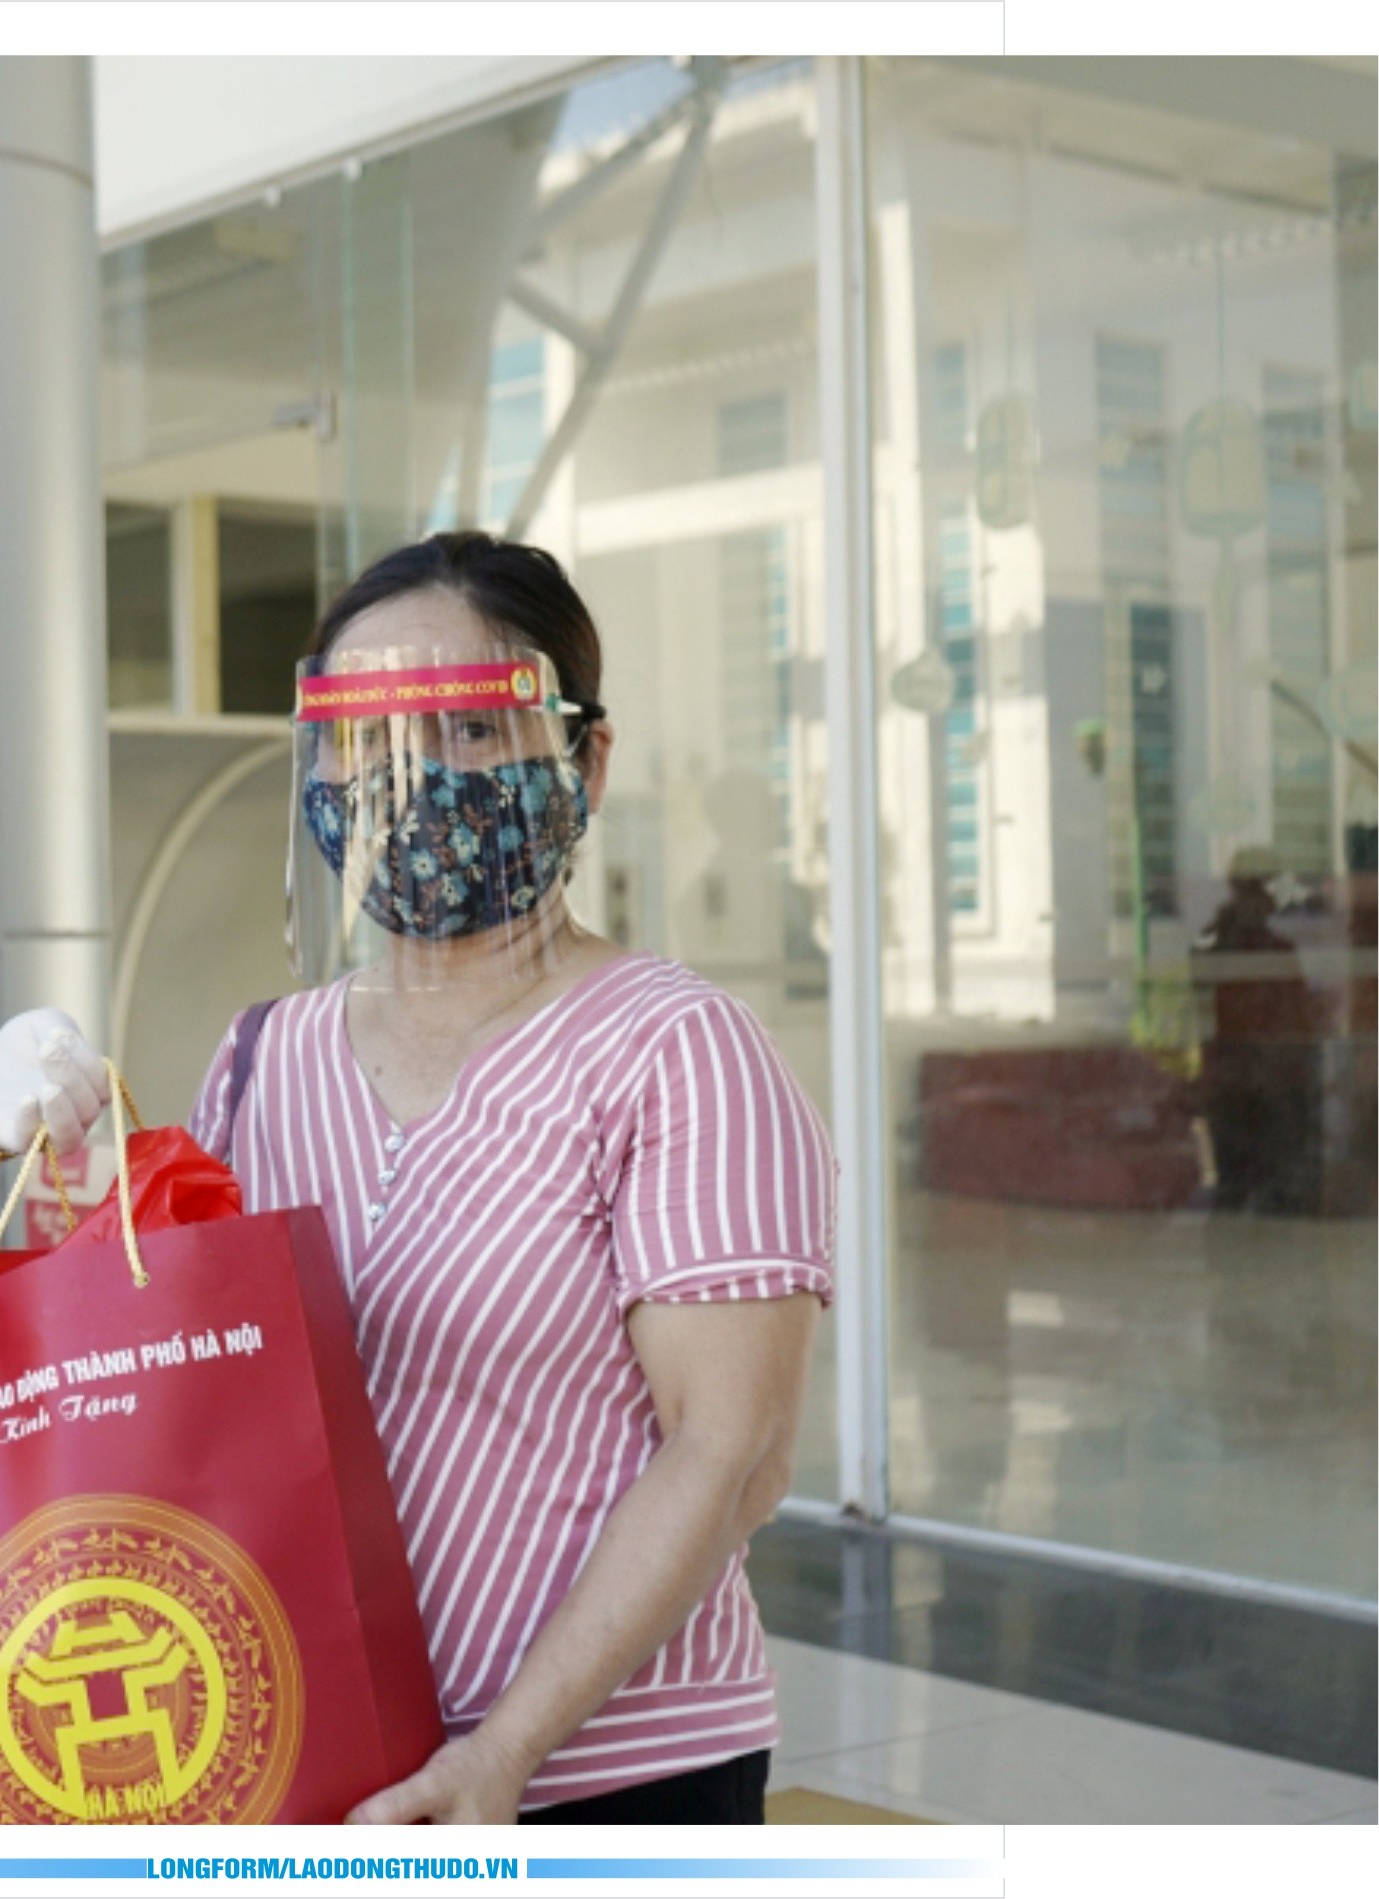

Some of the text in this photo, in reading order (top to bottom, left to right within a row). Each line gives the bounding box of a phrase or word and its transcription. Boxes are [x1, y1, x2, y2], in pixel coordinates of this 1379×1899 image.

[62, 1350, 137, 1385] THÀNH
[140, 1330, 186, 1370] PHỐ
[190, 1328, 222, 1361] HÀ
[224, 1321, 263, 1358] NỘI
